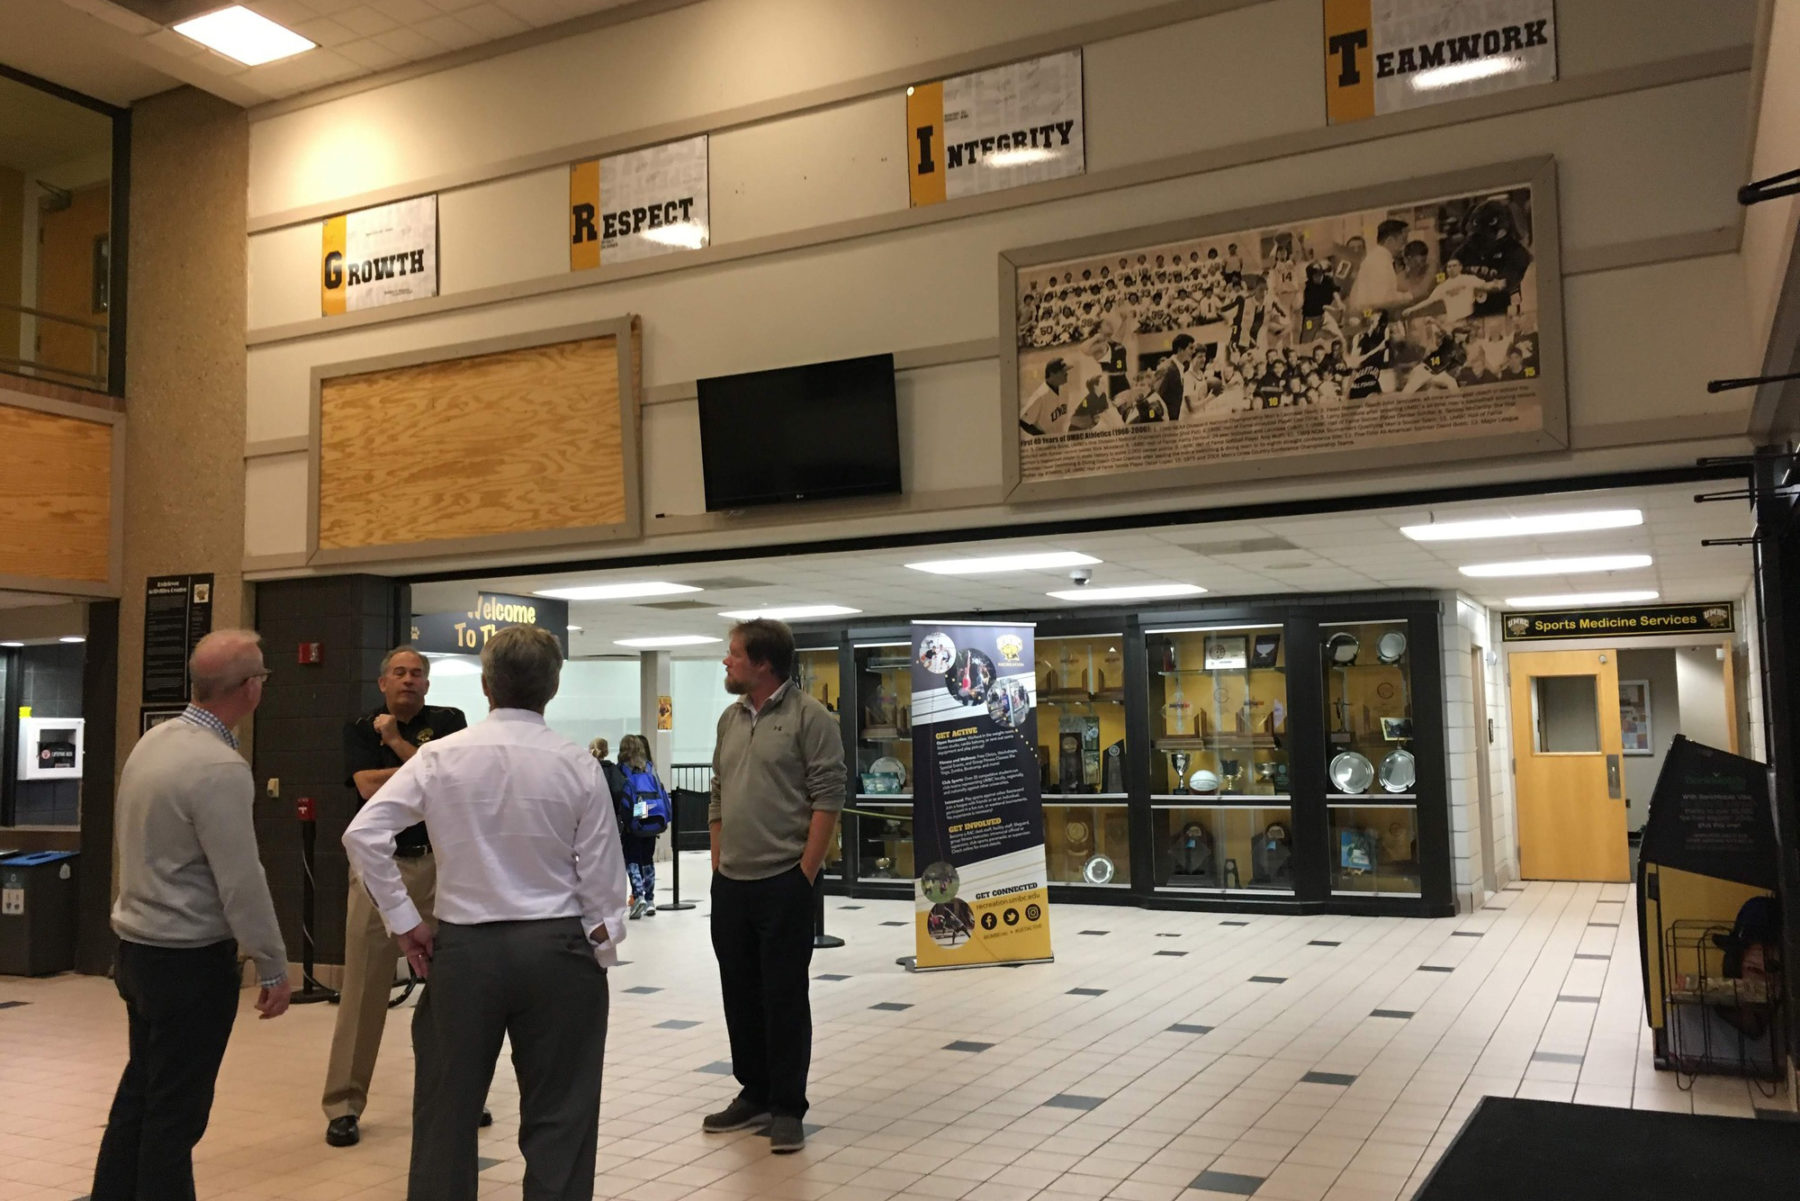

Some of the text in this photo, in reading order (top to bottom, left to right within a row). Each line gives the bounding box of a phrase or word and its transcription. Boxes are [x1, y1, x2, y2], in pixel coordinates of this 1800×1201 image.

[1329, 19, 1547, 88] TEAMWORK
[917, 119, 1074, 176] INTEGRITY
[573, 197, 693, 244] RESPECT
[325, 249, 424, 290] GROWTH
[1085, 430, 1111, 439] Athletics
[1703, 607, 1728, 619] UMBC
[1535, 614, 1697, 632] Sports Medicine Services
[454, 622, 476, 648] To
[936, 727, 978, 740] GET ACTIVE
[948, 818, 1001, 833] GET INVOLVED
[976, 882, 1038, 900] GET CONNECTED
